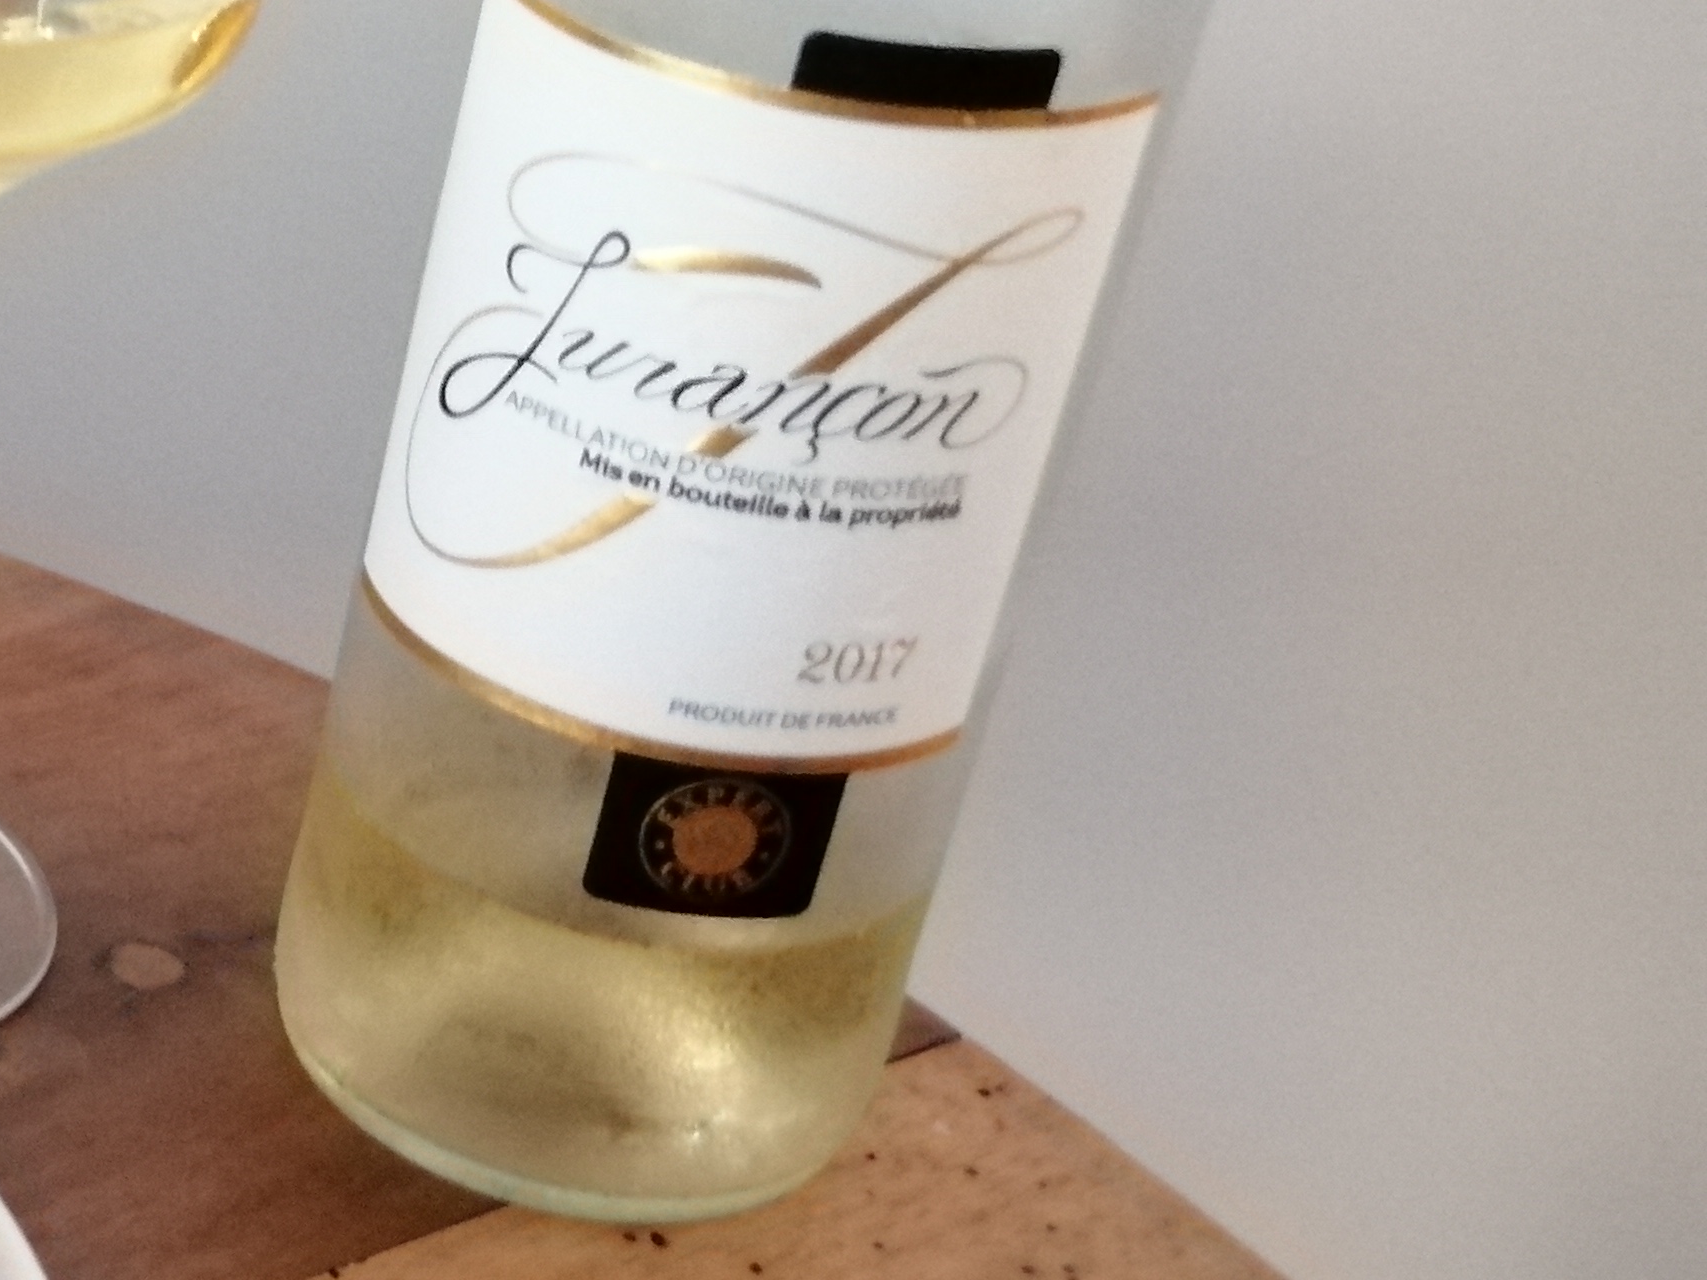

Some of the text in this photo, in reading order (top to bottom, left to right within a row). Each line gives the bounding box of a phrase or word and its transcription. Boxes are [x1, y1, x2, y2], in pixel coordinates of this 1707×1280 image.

[439, 231, 1029, 464] Jurançon
[505, 389, 670, 471] APPELLATION
[677, 454, 824, 500] D'ORIGINE
[579, 446, 962, 531] Mis en bouteille à la propriété
[796, 635, 919, 685] 2017
[668, 696, 900, 731] PRODUIT DE FRANCE
